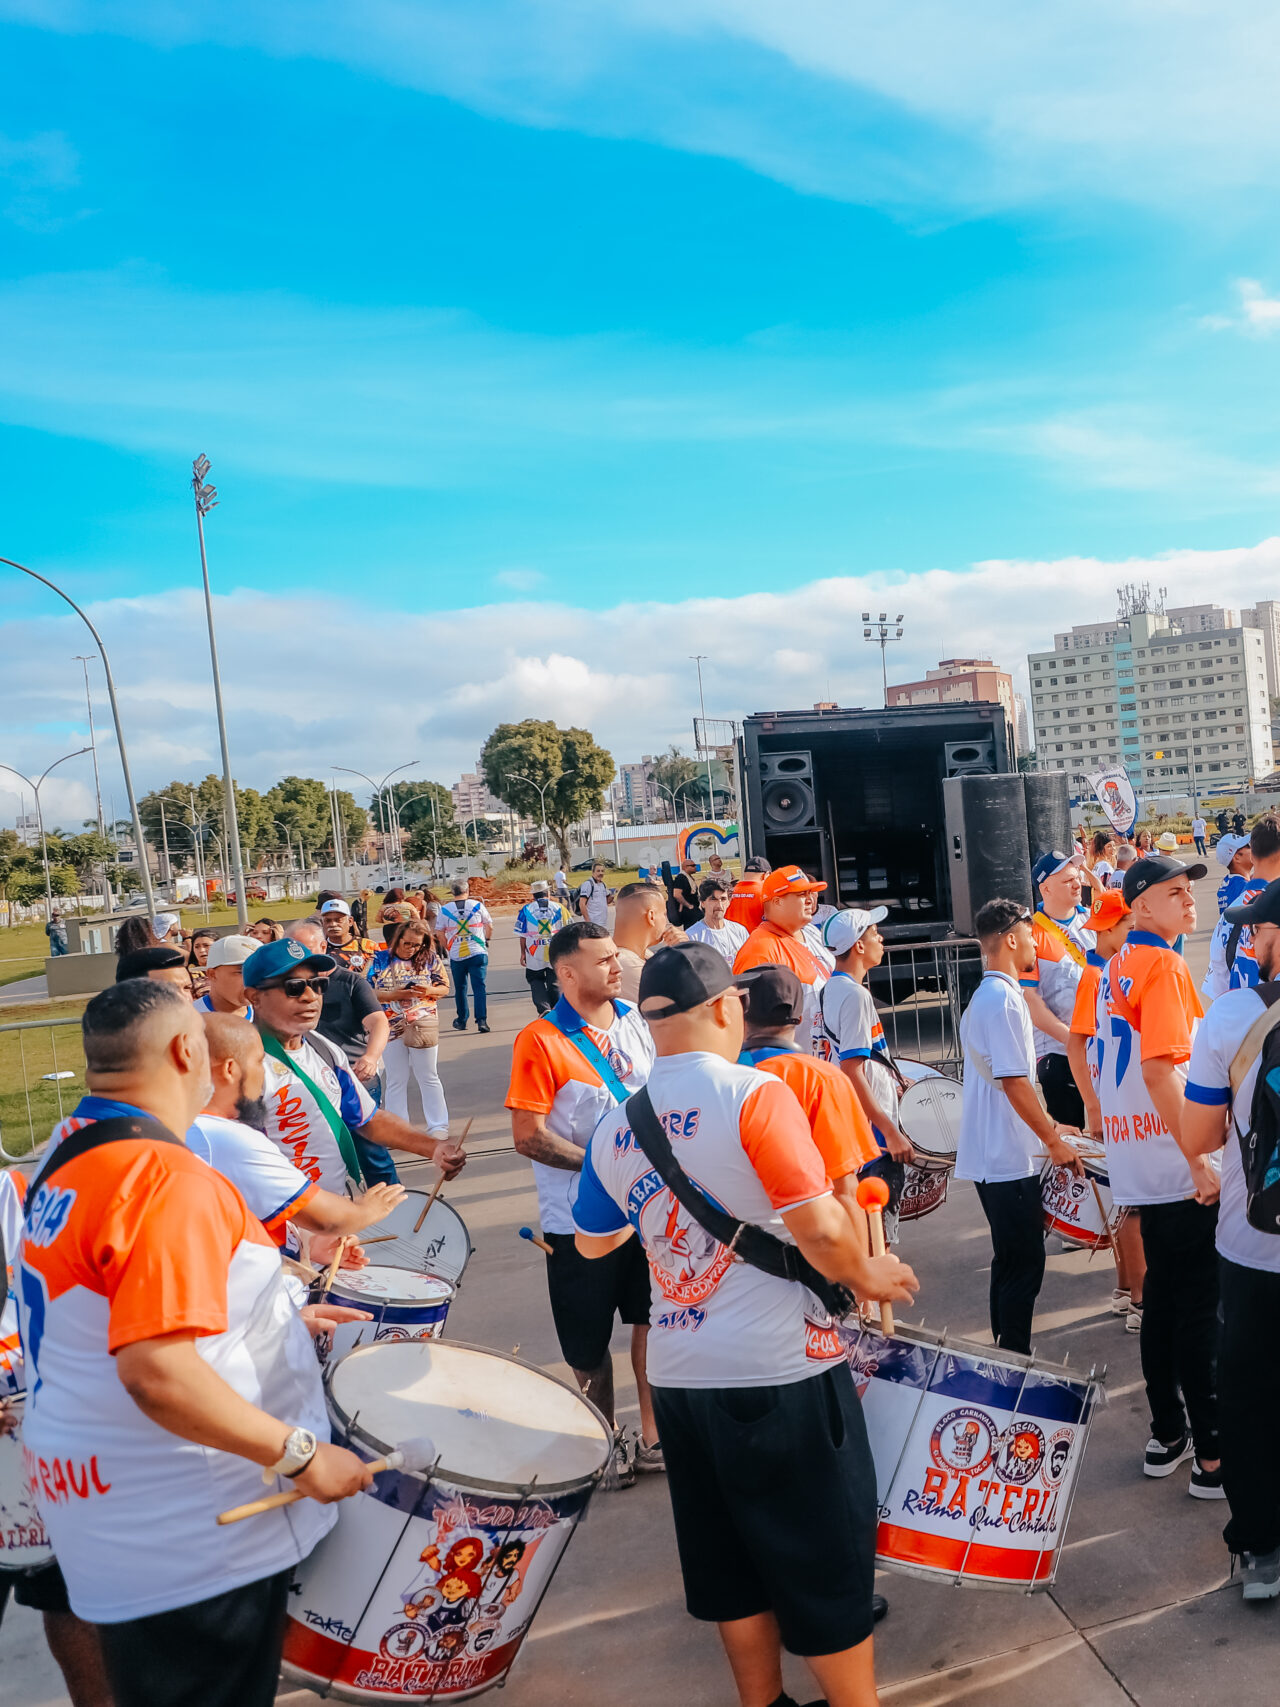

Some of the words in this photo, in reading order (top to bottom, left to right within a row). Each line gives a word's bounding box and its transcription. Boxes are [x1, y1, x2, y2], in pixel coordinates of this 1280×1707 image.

[935, 1412, 956, 1432] BLOCO
[960, 1409, 997, 1436] CARNAVALES
[38, 1454, 112, 1504] RAUL
[901, 1489, 963, 1520] Ritmo
[969, 1505, 1004, 1532] Que
